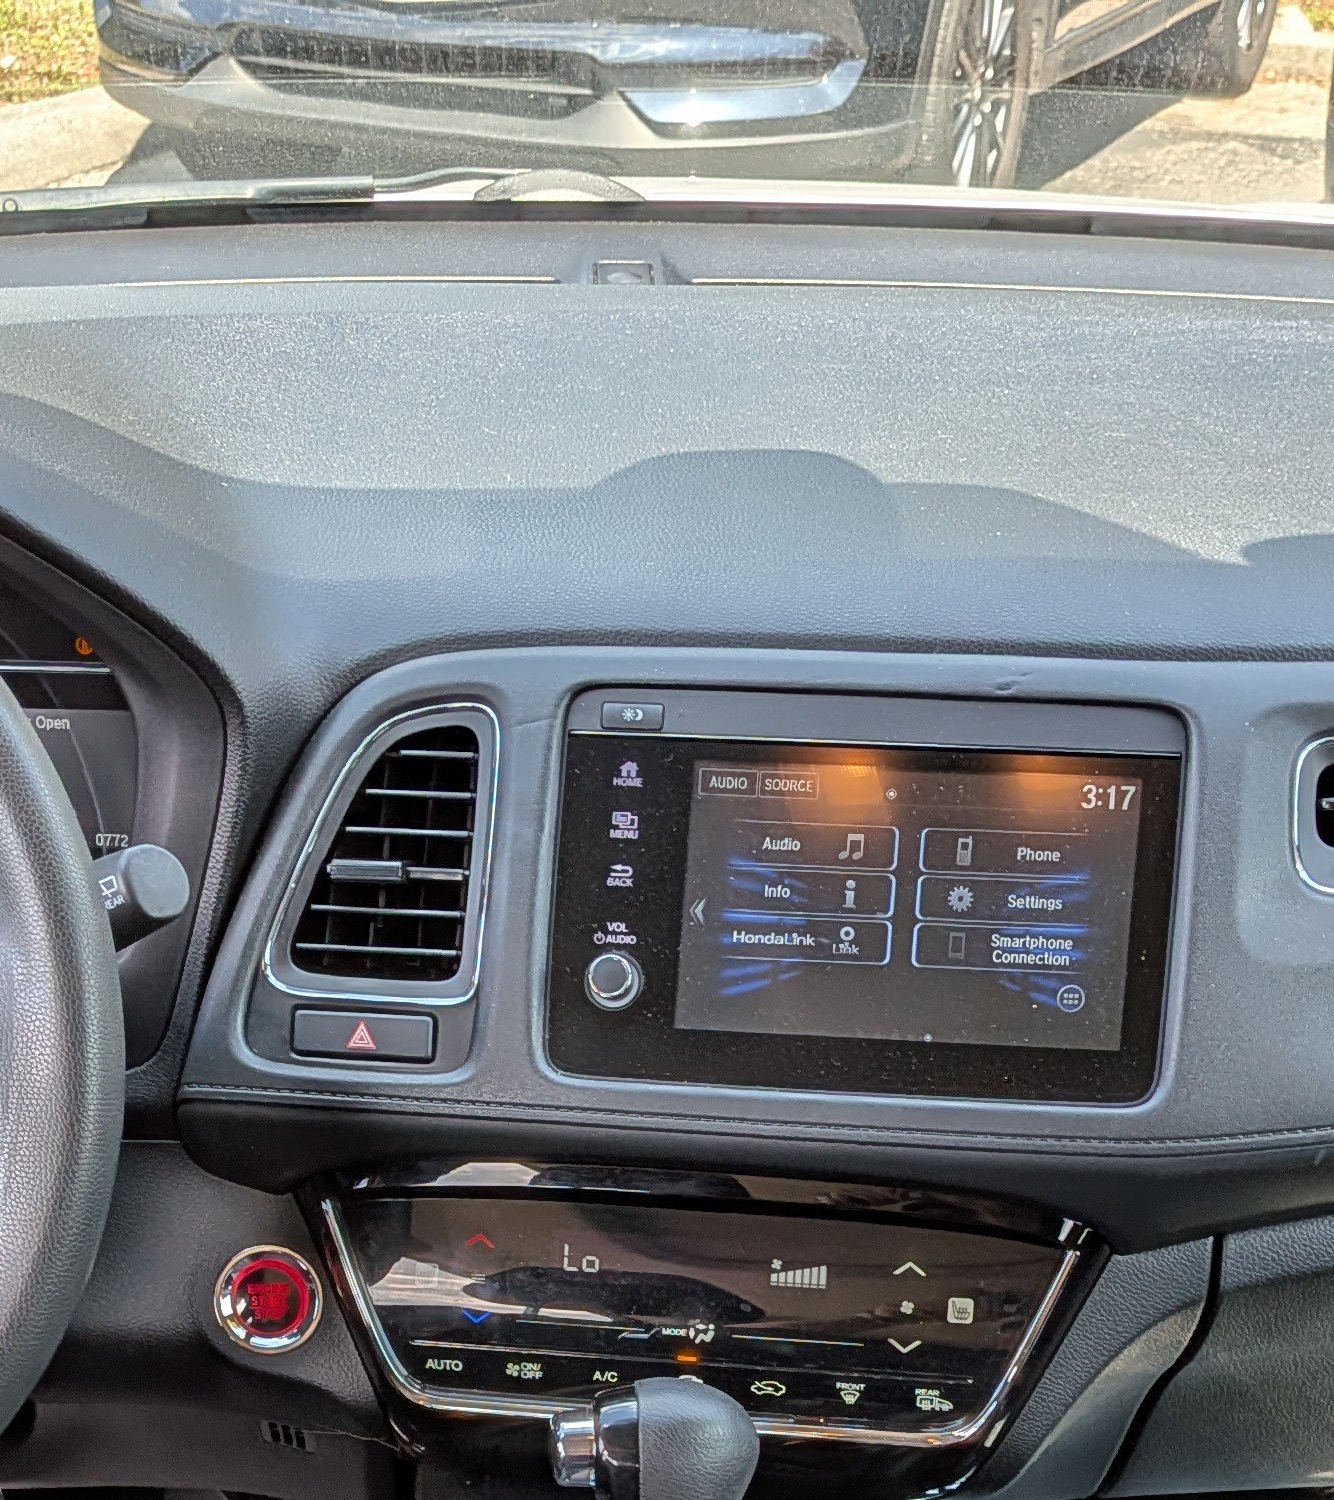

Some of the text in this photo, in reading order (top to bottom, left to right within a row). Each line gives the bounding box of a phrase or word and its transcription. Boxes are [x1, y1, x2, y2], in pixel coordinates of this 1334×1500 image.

[35, 715, 71, 731] Open
[613, 777, 643, 788] HOME
[709, 776, 814, 792] AUDIO SOURCE
[1080, 785, 1135, 812] 3:17
[610, 829, 639, 840] MENU
[761, 837, 801, 851] Audio
[1017, 846, 1061, 862] Phone
[606, 878, 634, 888] BACK
[764, 884, 791, 899] Info
[1007, 895, 1064, 911] Settings
[607, 922, 630, 932] VOL
[606, 934, 637, 945] AUDIO
[732, 931, 816, 946] HondaLink
[991, 933, 1074, 952] Smartphone
[832, 943, 859, 956] Link
[992, 949, 1070, 967] Connection
[564, 1242, 601, 1274] Lo
[248, 1283, 291, 1294] ENGINE
[251, 1295, 289, 1308] START
[662, 1328, 687, 1336] MODE
[425, 1359, 463, 1371] AUTO
[520, 1371, 543, 1379] OFF
[593, 1371, 618, 1382] A/C
[836, 1381, 866, 1391] FRONT
[914, 1388, 940, 1397] REAR
